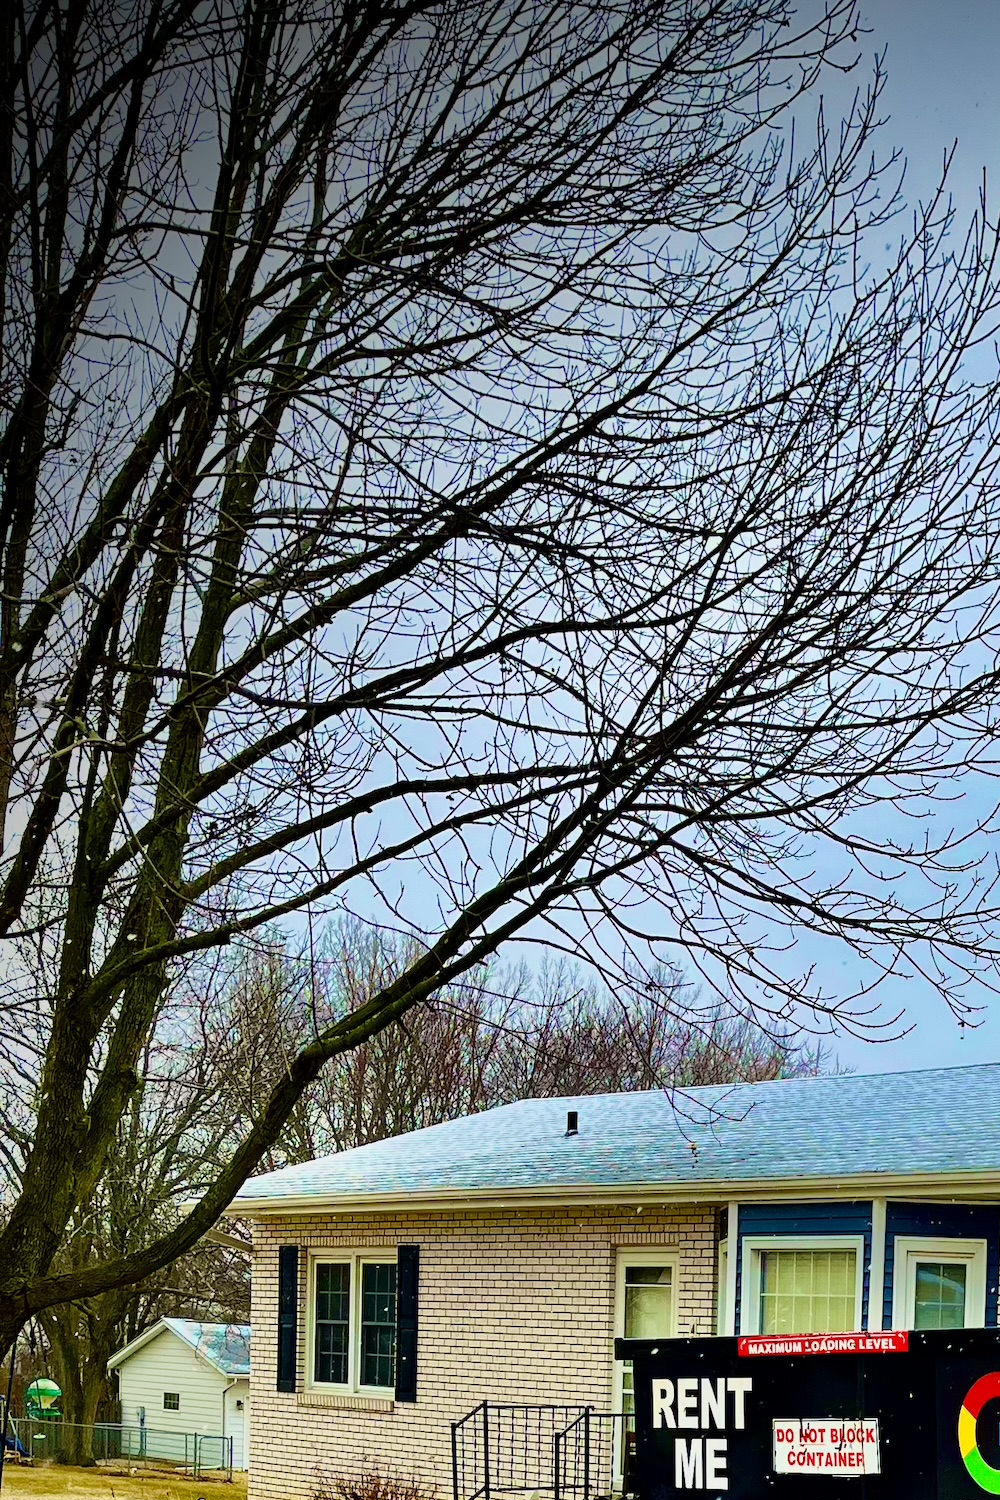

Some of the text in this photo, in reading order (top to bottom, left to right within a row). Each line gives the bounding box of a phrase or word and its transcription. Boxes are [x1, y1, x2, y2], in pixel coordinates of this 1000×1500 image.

[749, 1337, 896, 1354] MAXIMUM LOADING LEVEL
[652, 1377, 752, 1430] RENT
[777, 1428, 876, 1444] DO NOT BLOCK
[675, 1438, 729, 1491] ME
[788, 1451, 865, 1467] CONTAINER
